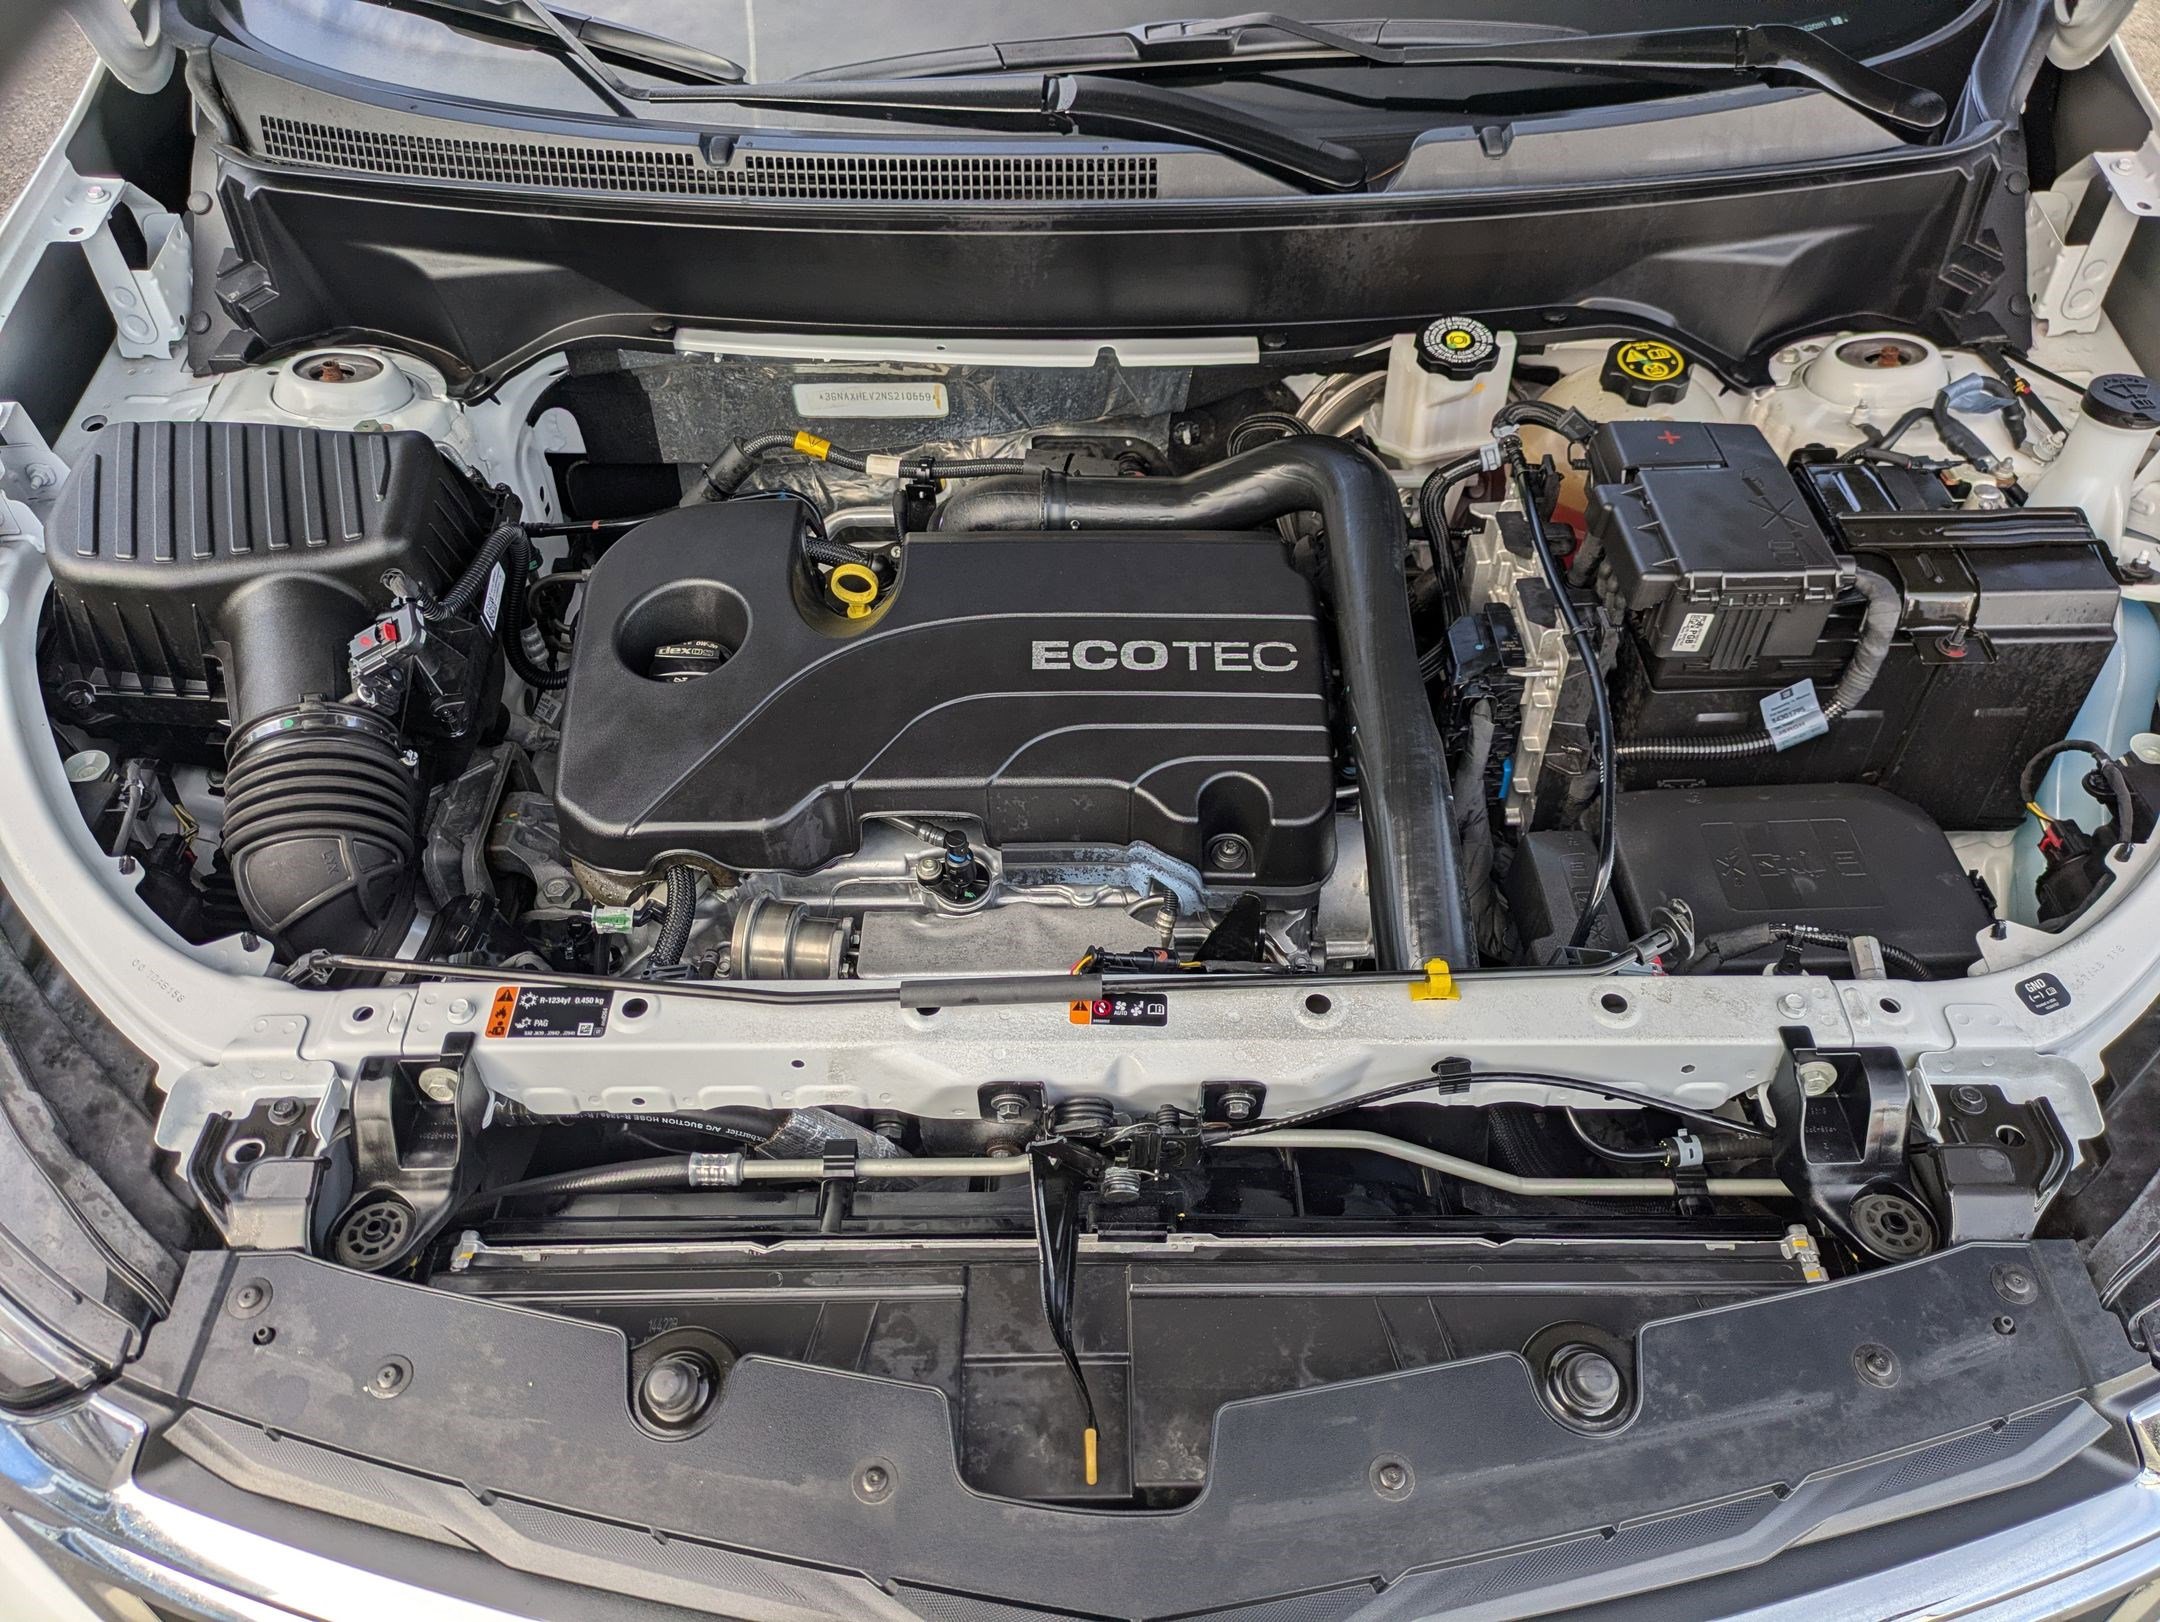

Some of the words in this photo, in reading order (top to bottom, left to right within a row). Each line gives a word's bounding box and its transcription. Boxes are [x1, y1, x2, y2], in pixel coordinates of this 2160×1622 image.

[1031, 640, 1299, 672] ECOTEC
[2025, 979, 2046, 993] GND
[539, 996, 571, 1005] R-1234yf
[594, 996, 605, 1006] kg
[533, 1019, 549, 1027] PAG
[633, 1113, 660, 1122] HOSE
[661, 1116, 704, 1129] SUCTION
